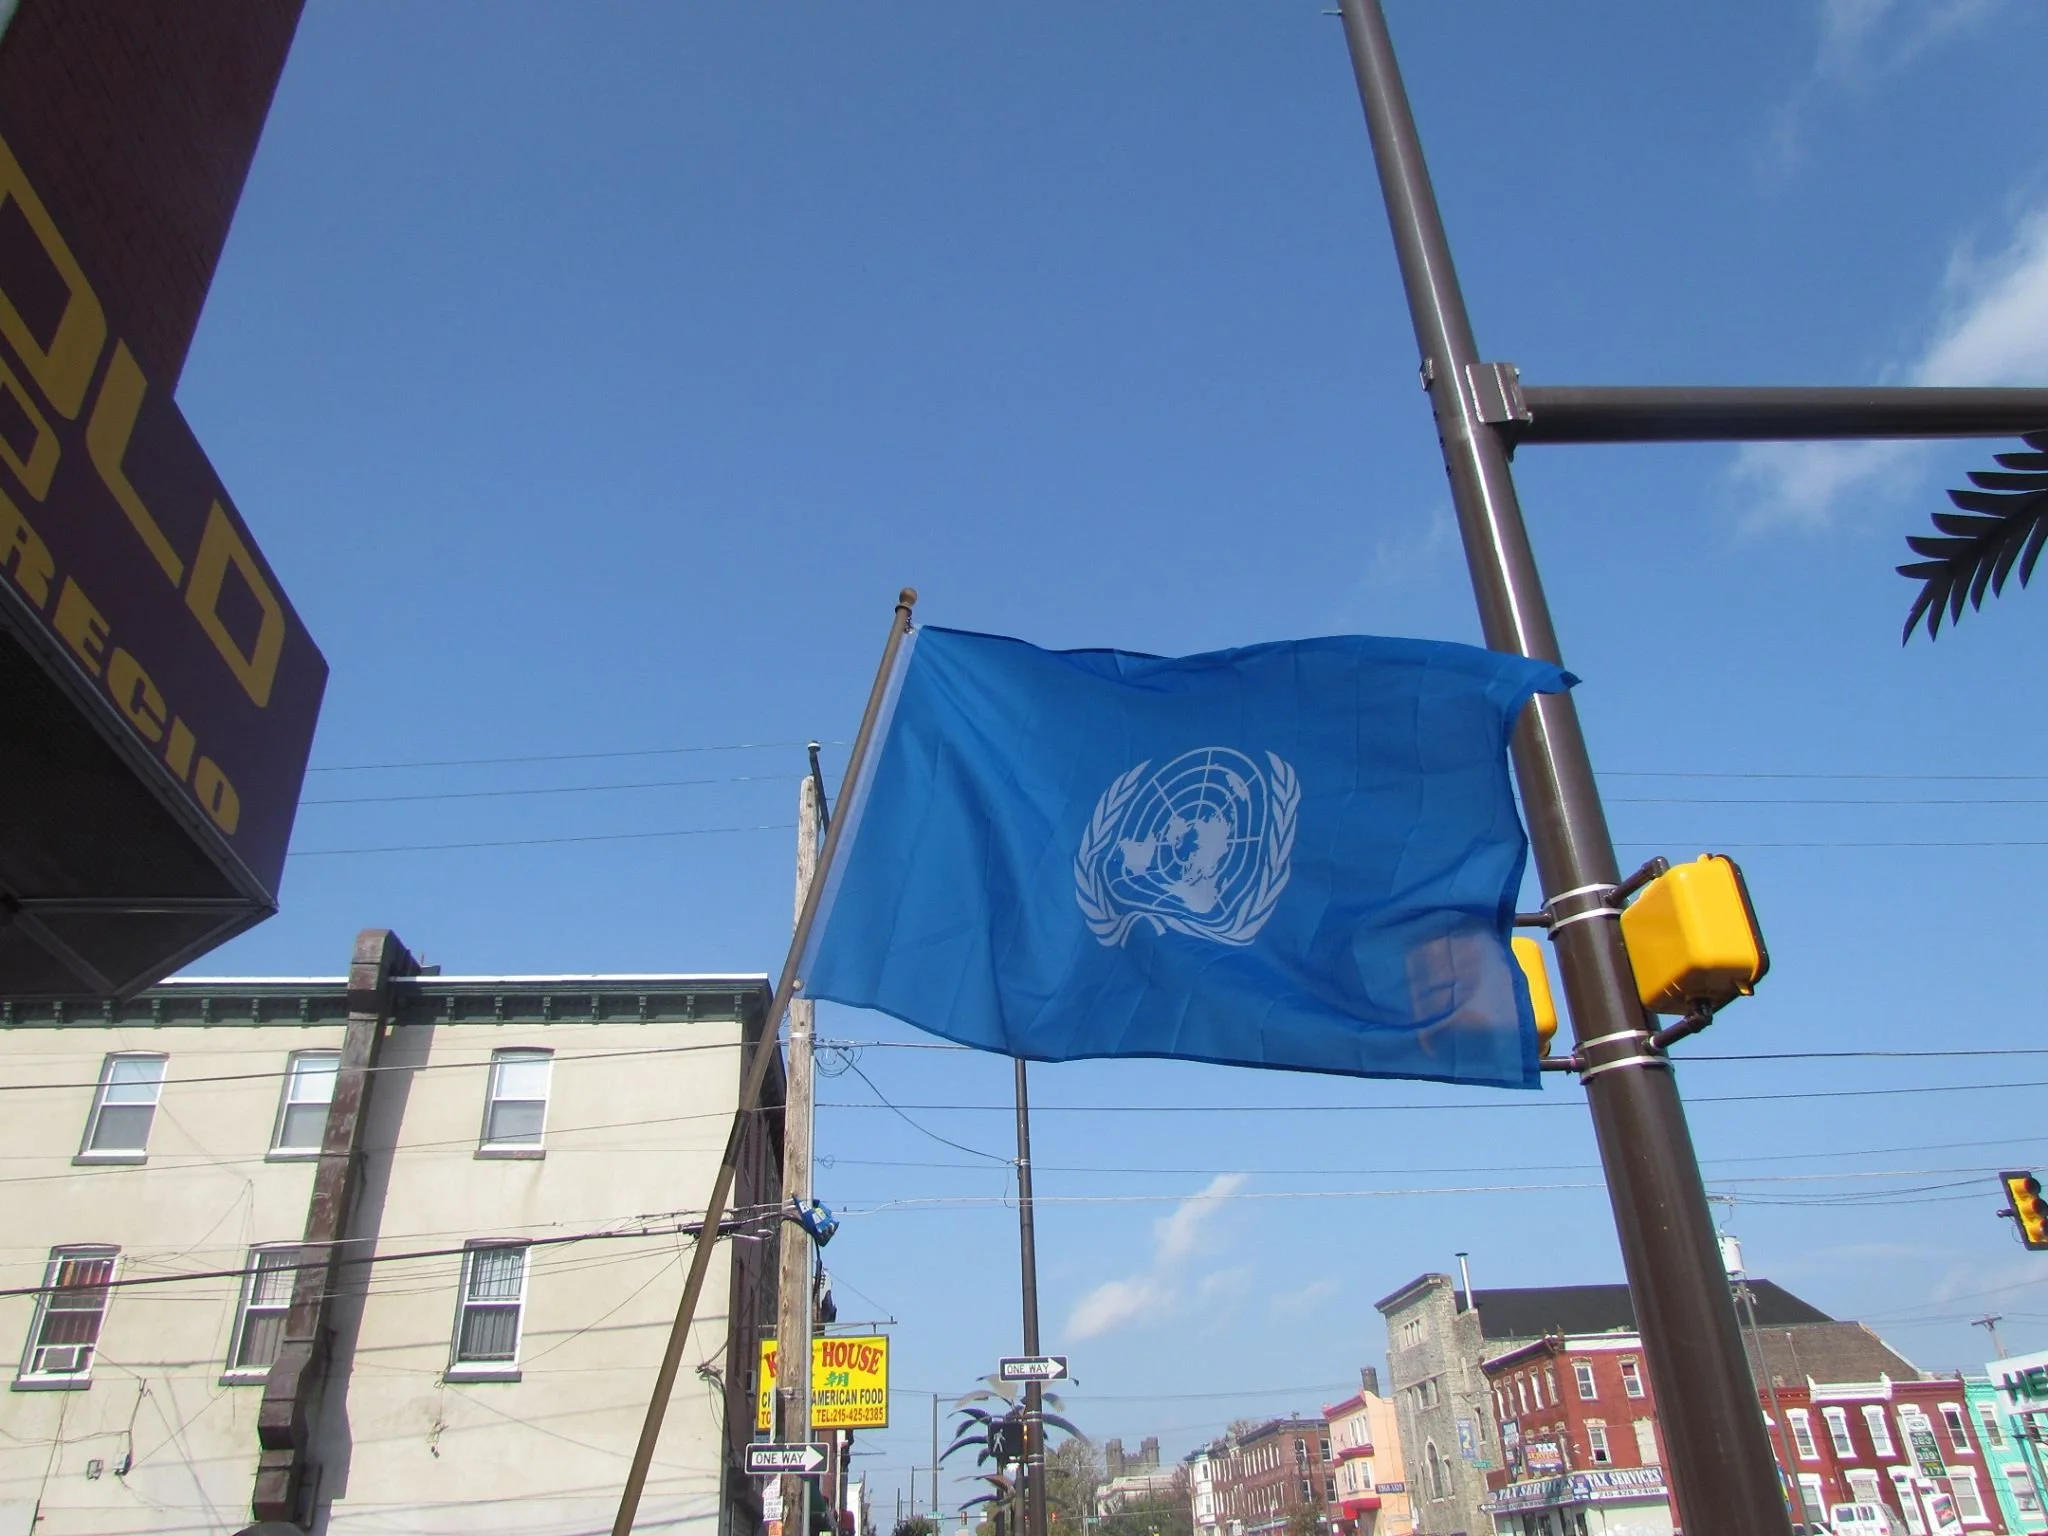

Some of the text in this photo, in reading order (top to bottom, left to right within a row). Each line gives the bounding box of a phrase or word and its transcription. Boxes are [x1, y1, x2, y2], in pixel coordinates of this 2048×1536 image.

[821, 1341, 884, 1375] HOUSE
[1007, 1363, 1049, 1374] ONE WAY
[2002, 1362, 2048, 1406] HE
[812, 1388, 884, 1406] AMERICAN FOOD
[816, 1407, 884, 1423] TEL:215-425-2385
[1535, 1442, 1558, 1453] TAX
[755, 1452, 804, 1465] ONE WAY
[1587, 1471, 1610, 1491] TAX
[1611, 1467, 1662, 1486] SERVICES
[1498, 1486, 1519, 1501] TAX
